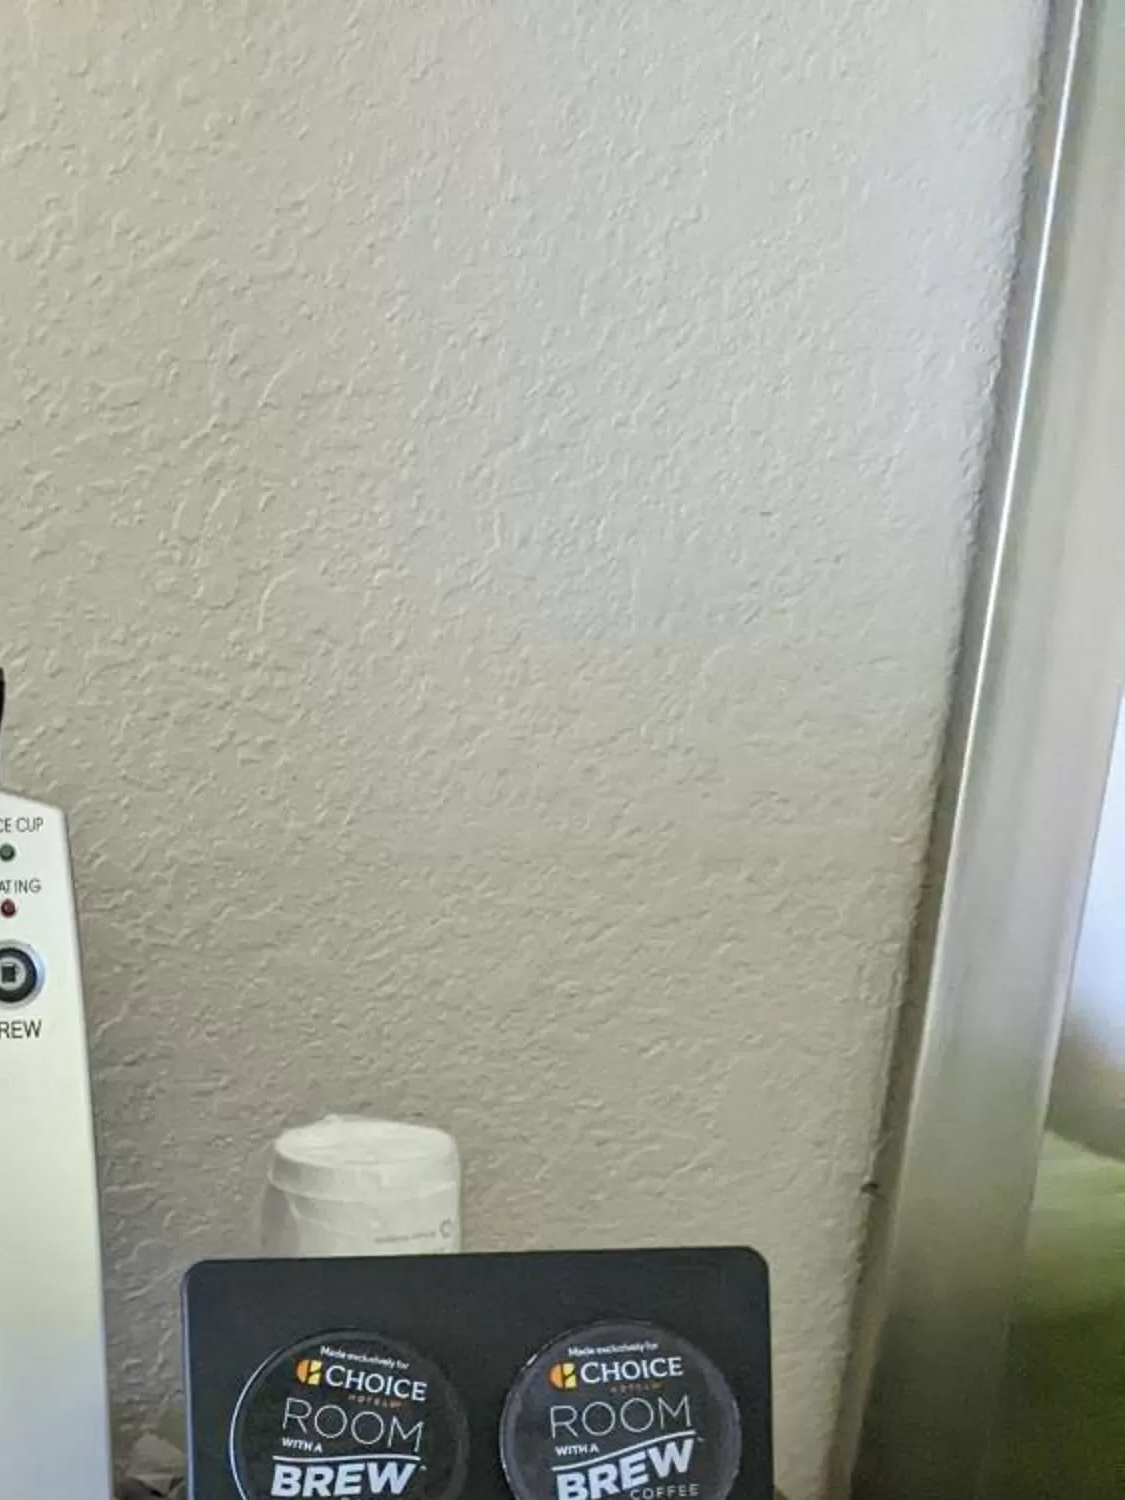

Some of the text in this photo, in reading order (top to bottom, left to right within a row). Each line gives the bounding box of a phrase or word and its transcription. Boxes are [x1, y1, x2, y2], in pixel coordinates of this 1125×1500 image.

[15, 816, 44, 833] CUP
[325, 1364, 428, 1402] CHOICE
[579, 1356, 684, 1384] CHOICE
[282, 1397, 424, 1452] ROOM
[549, 1395, 692, 1439] ROOM
[281, 1437, 323, 1453] WITH A
[555, 1443, 600, 1457] WITH A
[271, 1462, 416, 1497] BREW
[630, 1483, 700, 1500] COFFEE
